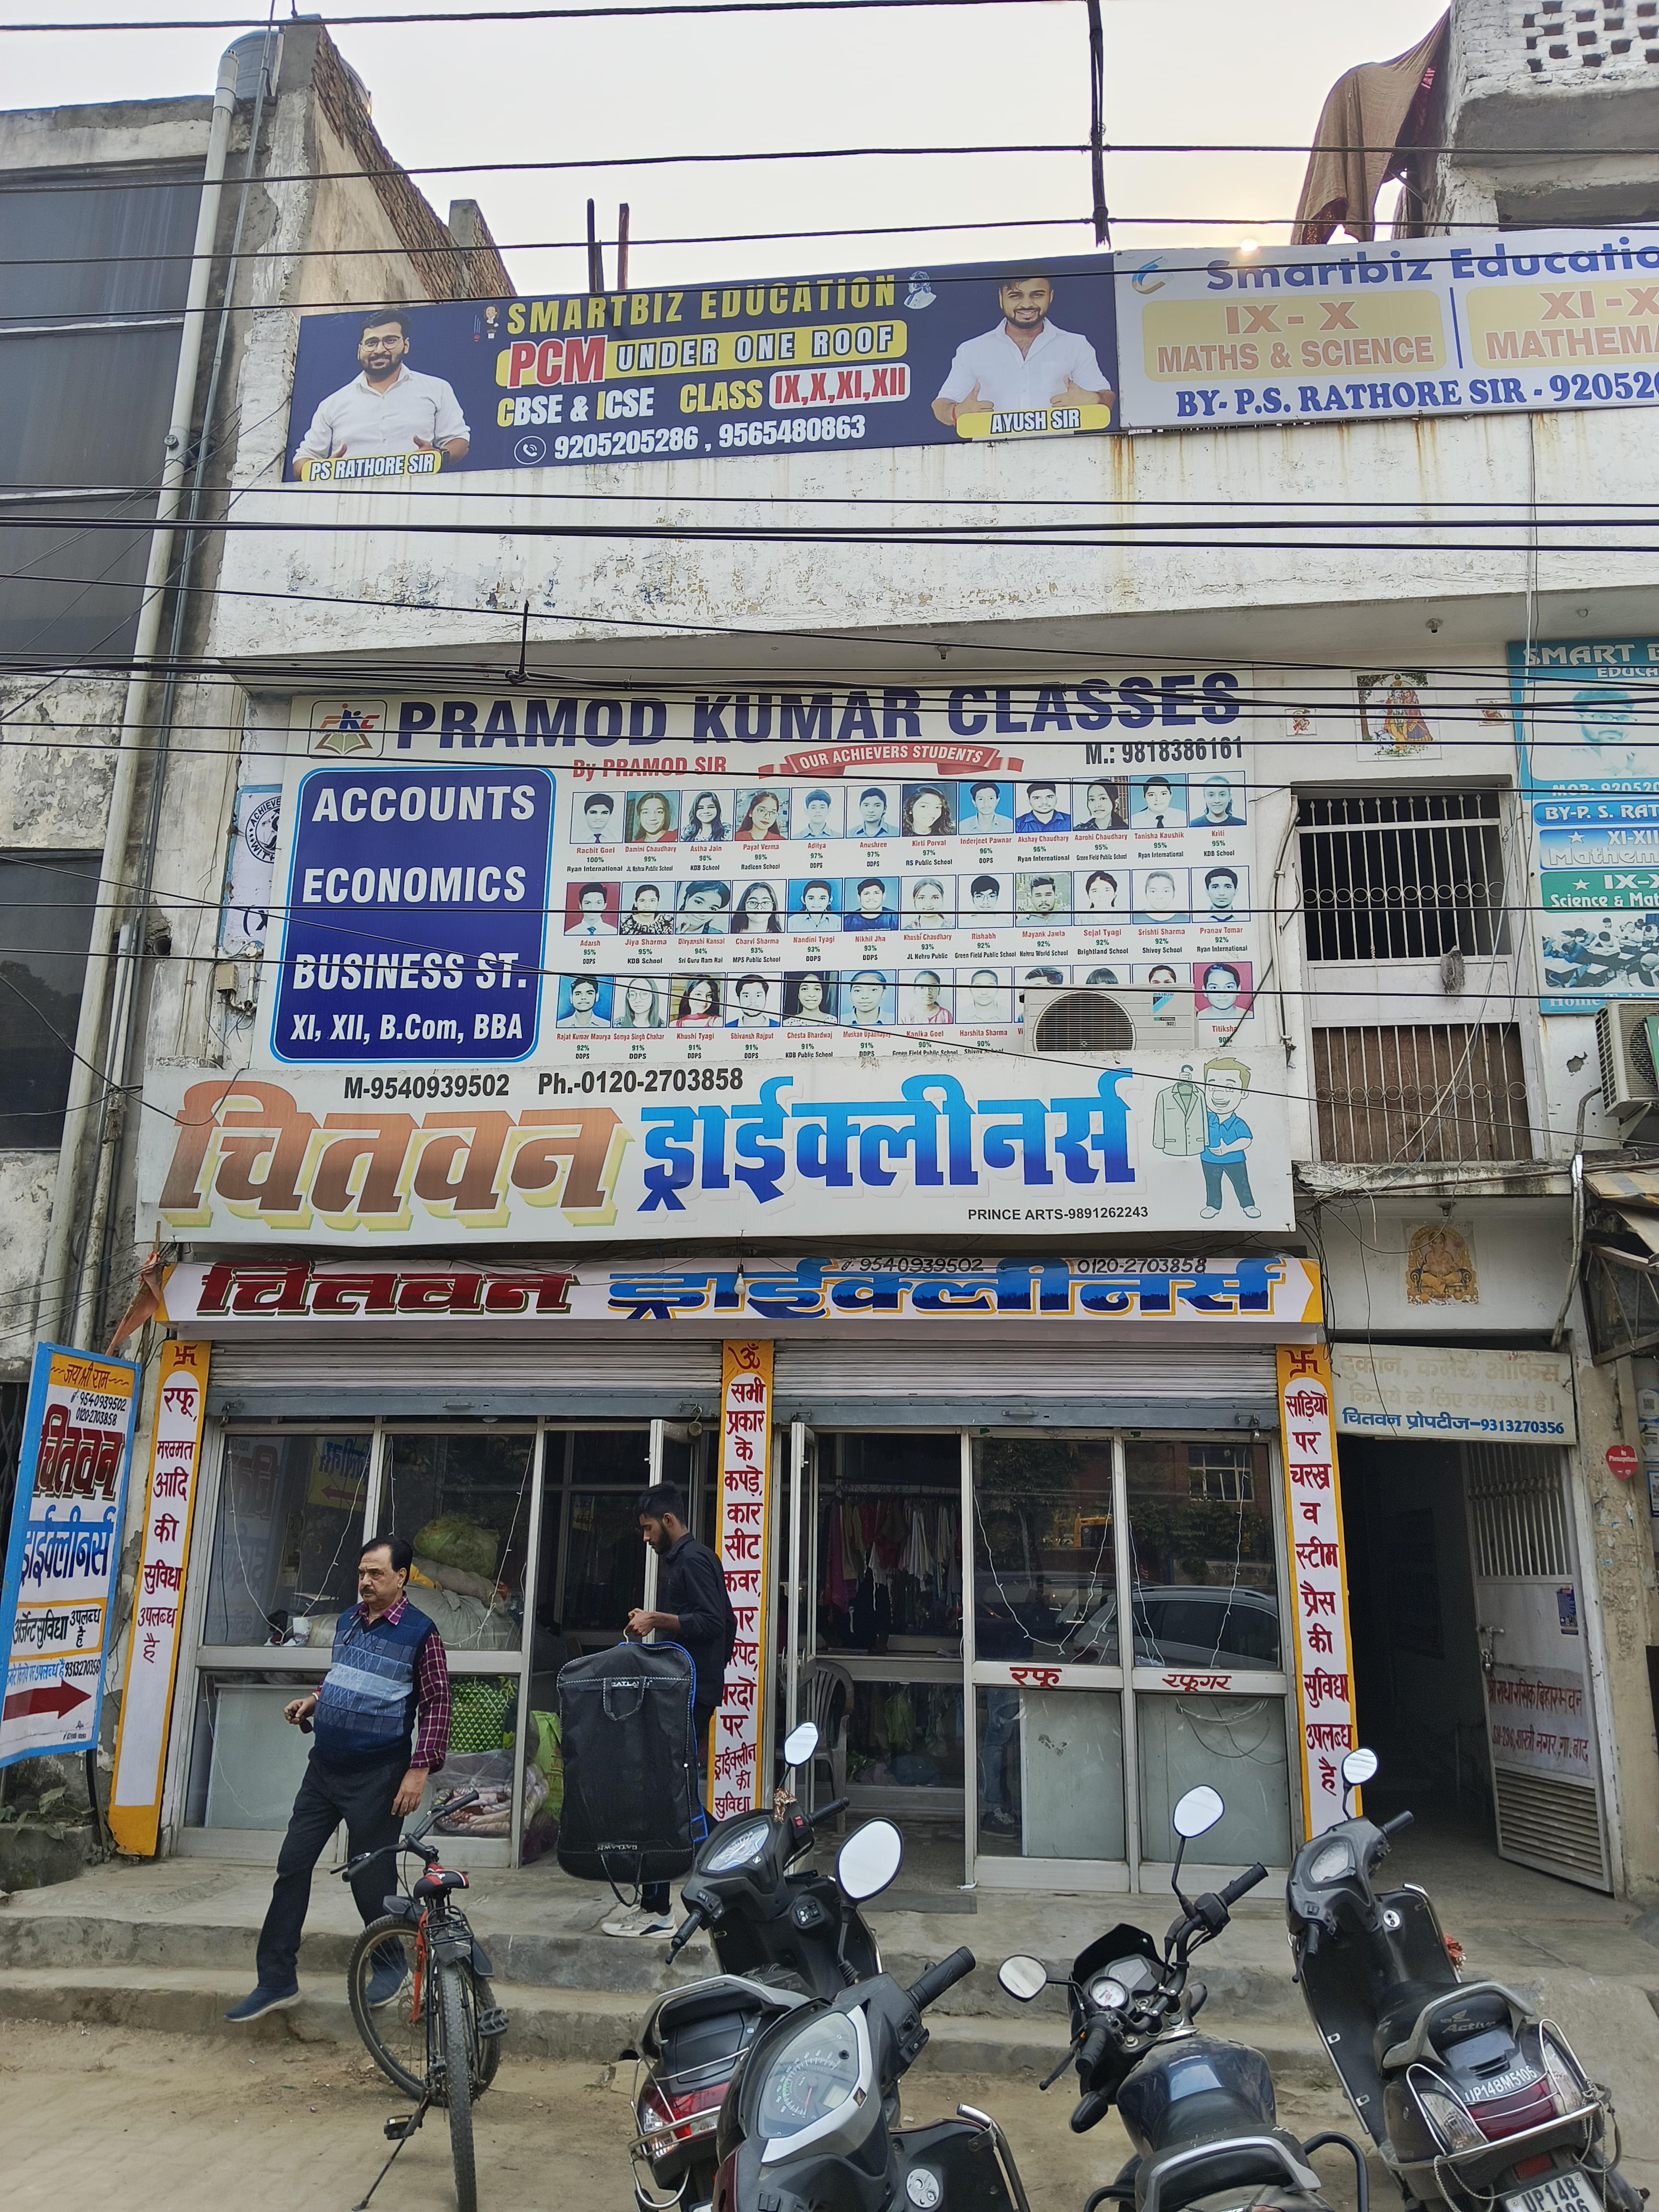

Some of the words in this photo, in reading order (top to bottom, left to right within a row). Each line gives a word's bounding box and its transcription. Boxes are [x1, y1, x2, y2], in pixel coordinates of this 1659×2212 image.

[1207, 251, 1432, 290] Smartbiz
[506, 291, 684, 335] SMARTBIZ
[700, 274, 895, 319] EDUCATION
[1226, 303, 1279, 335] IX
[1319, 301, 1359, 330] X
[1539, 290, 1596, 320] XI
[508, 335, 608, 389] PCM
[616, 337, 718, 372] UNDER
[735, 332, 795, 363] ONE
[812, 325, 894, 358] ROOF
[1157, 339, 1259, 374] MATHS
[1270, 342, 1292, 369] &
[1301, 336, 1435, 368] SCIENCE
[1485, 325, 1659, 360] MATHEM
[497, 394, 562, 428] CBSE
[570, 396, 589, 422] &
[597, 387, 655, 421] ICSE
[680, 379, 763, 414] CLASS
[1298, 380, 1462, 412] RATHORE
[1469, 378, 1527, 404] SIR
[1550, 372, 1659, 401] 92052
[554, 426, 698, 459] 9205205286
[719, 415, 866, 449] 9565480863
[990, 410, 1046, 434] AYUSH
[1052, 409, 1081, 430] SIR
[310, 461, 331, 481] PS
[335, 455, 406, 480] RATHORE
[409, 453, 435, 474] SIR
[1523, 644, 1635, 665] SMART
[397, 698, 667, 749] PRAMOD
[693, 688, 922, 744] KUMAR
[948, 672, 1240, 736] CLASSES
[799, 753, 829, 770] OUR
[832, 745, 909, 764] ACHIEVERS
[912, 745, 984, 764] STUDENTS
[1122, 735, 1243, 764] 9818386161
[573, 758, 595, 782] By
[602, 757, 687, 779] PRAMOD
[695, 756, 727, 774] SIR
[311, 785, 536, 822] ACCOUNTS
[302, 866, 528, 904] ECONOMICS
[1550, 893, 1608, 907] Science
[292, 952, 467, 990] BUSINESS
[476, 951, 527, 989] ST.
[290, 1014, 322, 1043] XI,
[330, 1014, 371, 1046] XII,
[380, 1013, 465, 1045] B.Com,
[473, 1013, 523, 1040] BBA
[344, 1073, 509, 1100] M-9540939502
[538, 1067, 743, 1095] Ph.-0120-2703858
[158, 1080, 631, 1222] चितवन
[637, 1067, 1137, 1212] ड्राईक्लीनर्स
[968, 1208, 1021, 1220] PRINCE
[1025, 1206, 1149, 1220] ARTS-9891262243
[859, 1257, 984, 1273] 9540939502
[1077, 1257, 1206, 1274] 0120-2703858
[196, 1261, 578, 1316] चितवन
[63, 1363, 81, 1385] जय
[92, 1369, 110, 1389] राम
[731, 1376, 766, 1404] सभी
[80, 1392, 127, 1412] 9540939502
[1285, 1390, 1328, 1422] साड़ियों
[1342, 1407, 1402, 1427] चितवन
[726, 1410, 765, 1436] प्रकार
[33, 1404, 126, 1501] चितवन
[734, 1435, 753, 1461] के
[1292, 1431, 1322, 1455] पर
[153, 1466, 189, 1501] आदि
[155, 1513, 180, 1544] की
[727, 1503, 764, 1526] कार
[1300, 1502, 1321, 1526] व
[724, 1527, 762, 1562] सीट
[1295, 1536, 1338, 1570] स्टीम
[144, 1559, 184, 1595] सुविधा
[138, 1607, 178, 1629] उपलब्ध
[144, 1633, 160, 1664] है
[1307, 1622, 1333, 1655] की
[1009, 1667, 1062, 1688] रफू
[1162, 1673, 1232, 1692] रफूगर
[1303, 1667, 1350, 1708] सुविधा
[720, 1714, 749, 1739] पर
[1306, 1724, 1354, 1752] उपलब्ध
[735, 1770, 751, 1791] की
[1318, 1756, 1337, 1797] है
[715, 1791, 751, 1819] सुविधा
